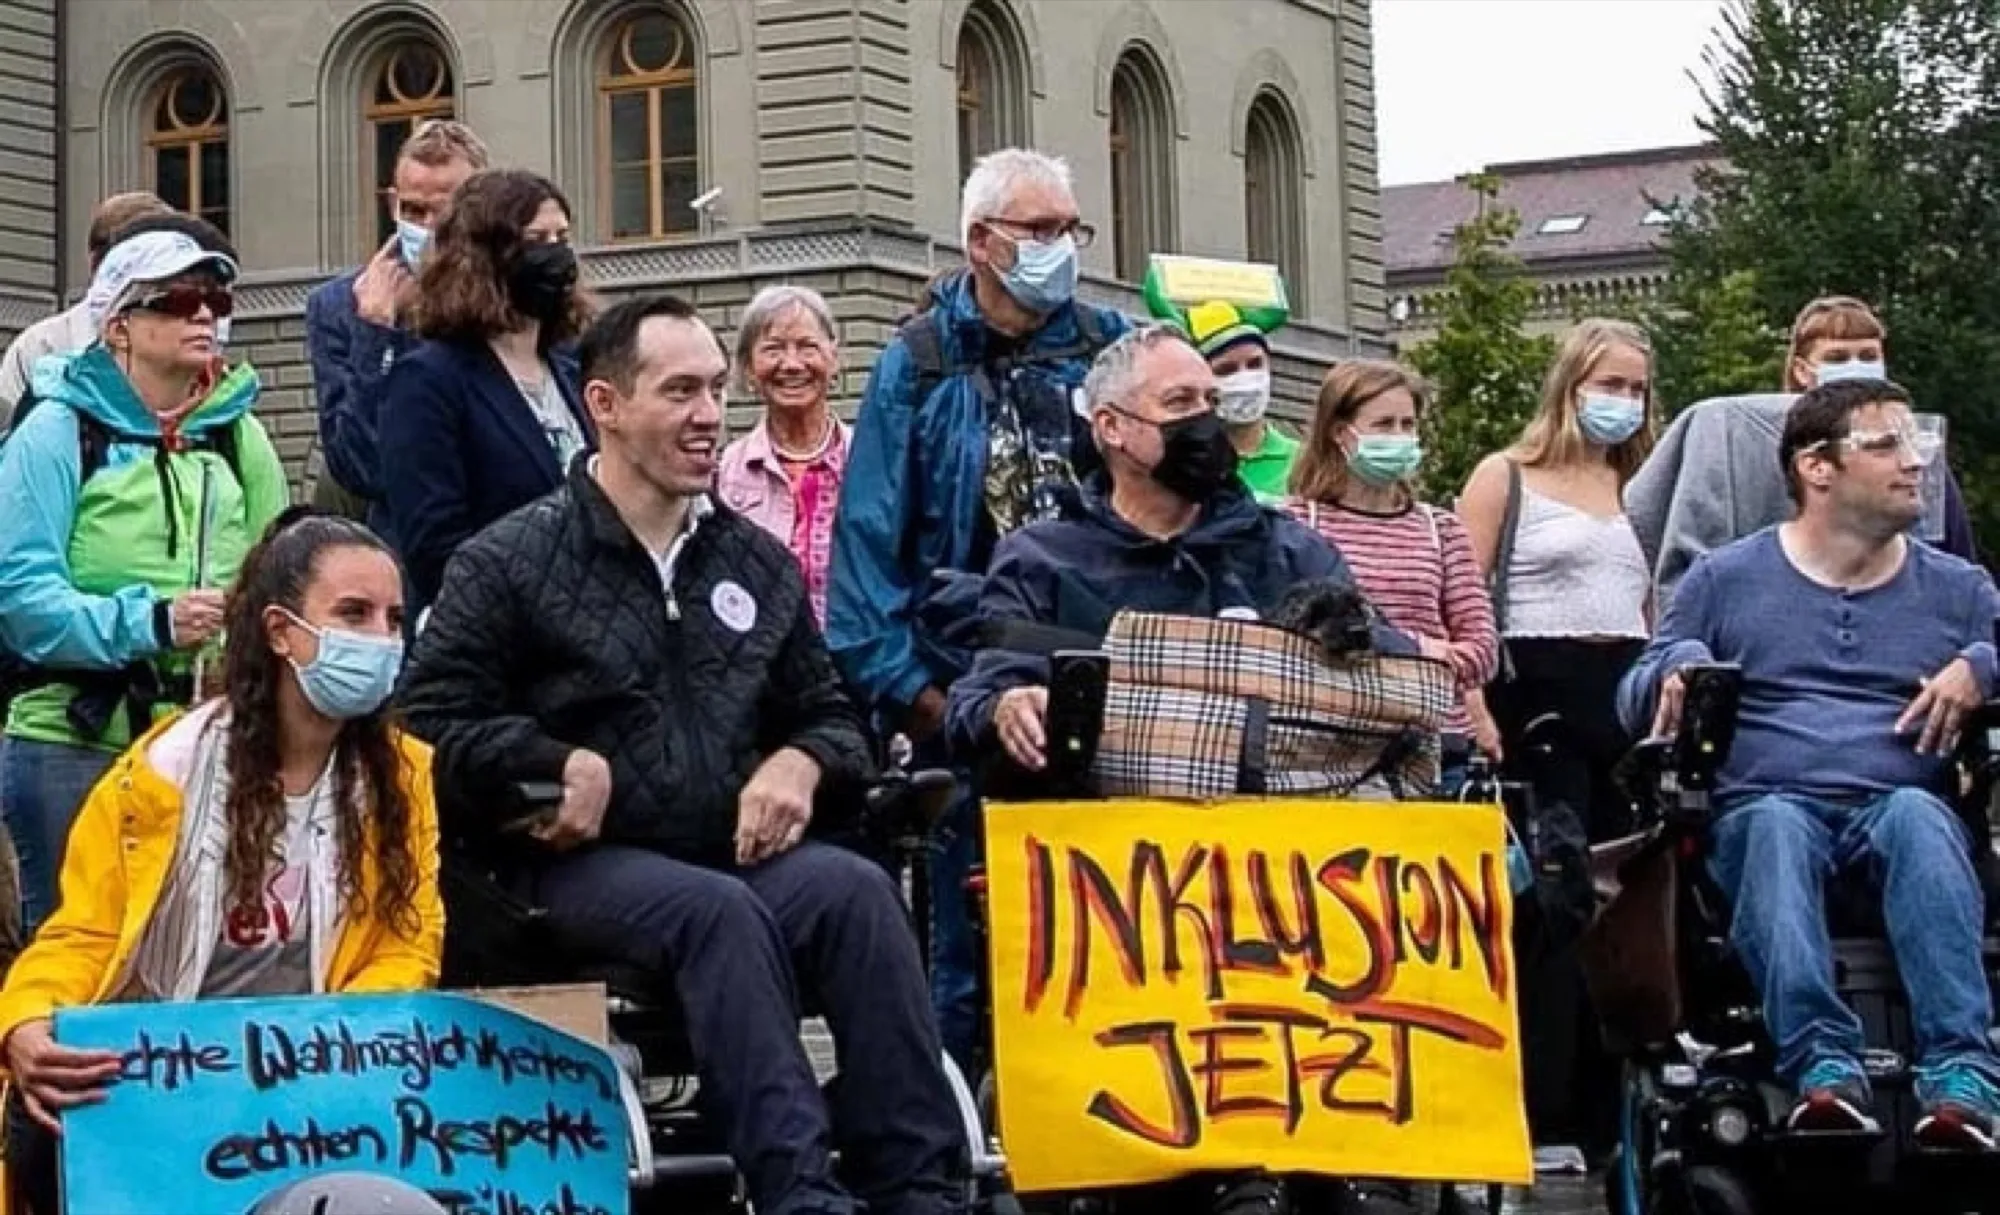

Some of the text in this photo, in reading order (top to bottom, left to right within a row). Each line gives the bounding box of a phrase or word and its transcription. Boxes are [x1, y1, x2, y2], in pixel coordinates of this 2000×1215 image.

[1023, 832, 1508, 1024] INKLUSION
[116, 1030, 240, 1090] chte
[1087, 1001, 1506, 1149] JETZT
[205, 1098, 608, 1180] echten Respekt
